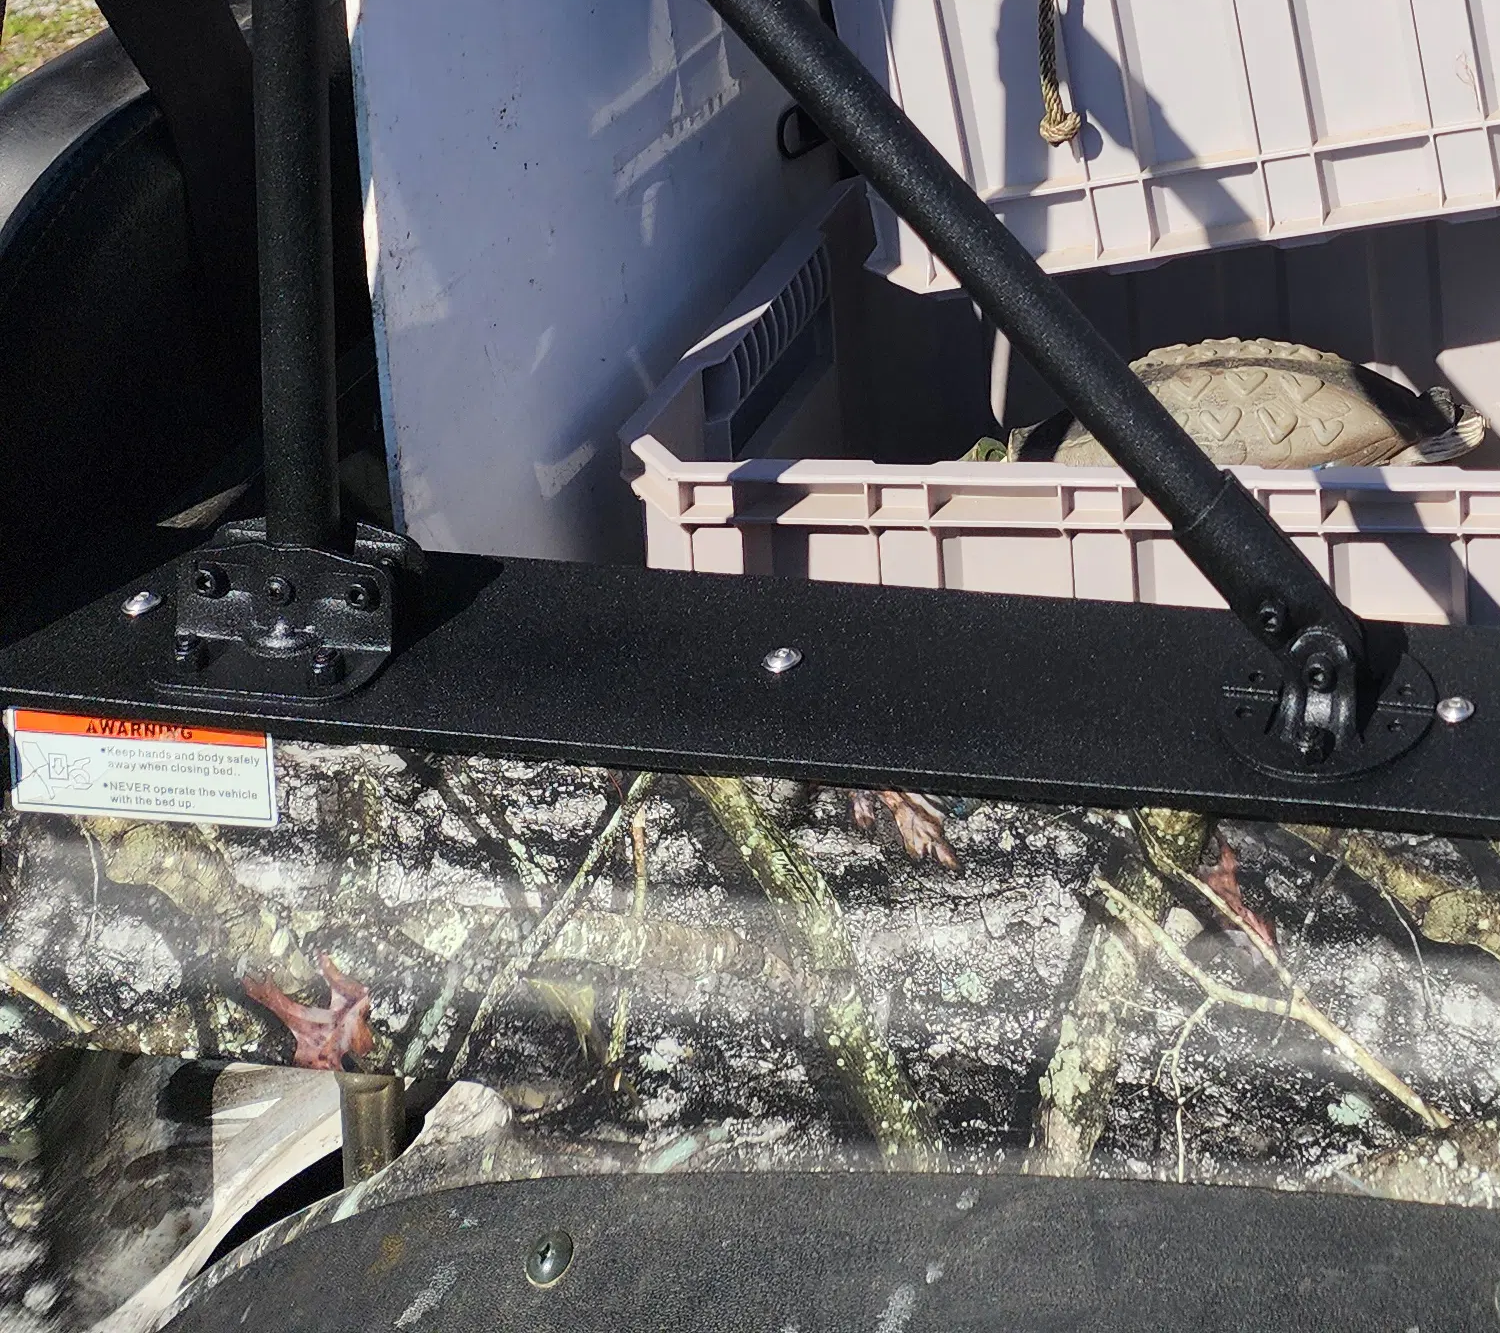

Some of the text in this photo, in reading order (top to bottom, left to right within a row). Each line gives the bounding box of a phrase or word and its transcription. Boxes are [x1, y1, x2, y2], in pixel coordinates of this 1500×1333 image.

[107, 745, 260, 767] Keep hands and body safely
[107, 760, 137, 772] away
[139, 762, 168, 772] when
[171, 763, 210, 776] closing
[109, 781, 258, 800] NEVER operate the vehicle
[110, 795, 196, 809] with the bed up.
